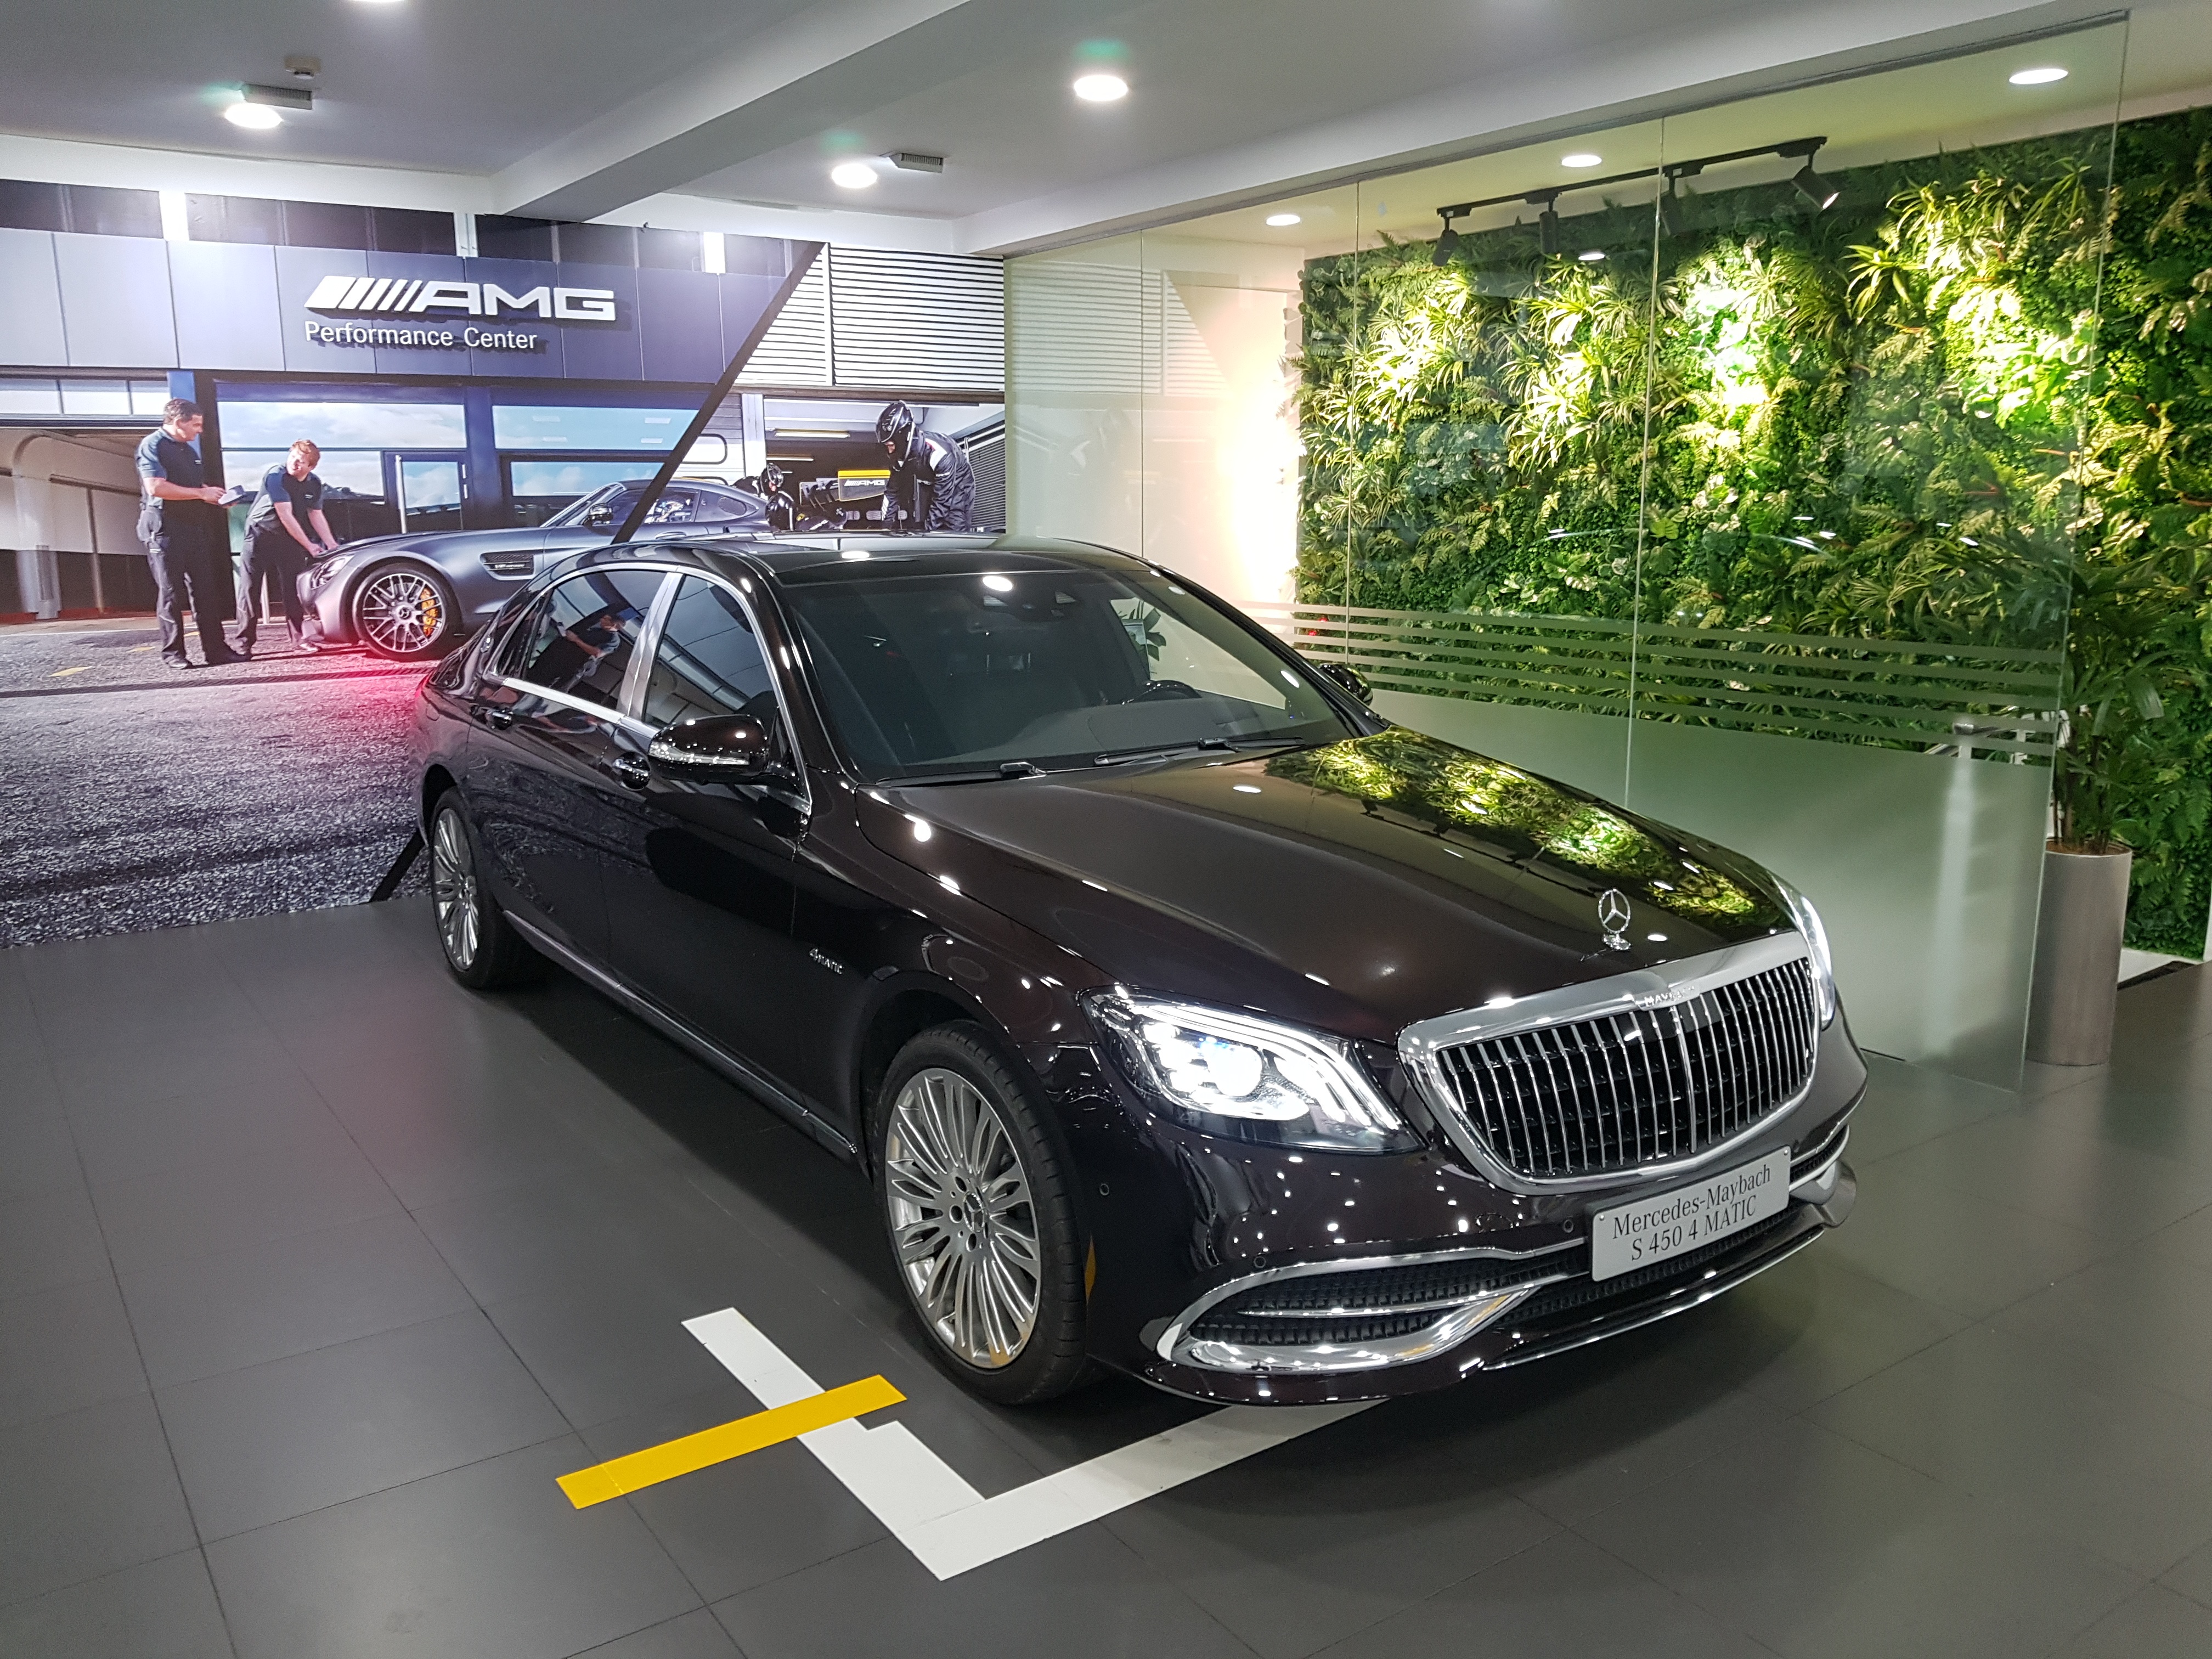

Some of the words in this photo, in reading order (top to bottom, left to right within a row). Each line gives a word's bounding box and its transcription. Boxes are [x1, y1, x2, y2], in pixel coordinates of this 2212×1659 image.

[409, 280, 616, 321] AMG
[304, 321, 453, 346] Performance
[464, 327, 538, 349] Center
[1612, 1164, 1770, 1240] Mercedes-Maybach
[1632, 1238, 1643, 1261] S
[1649, 1226, 1682, 1254] 450
[1688, 1219, 1698, 1240] 4
[1704, 1195, 1756, 1236] MATIC
